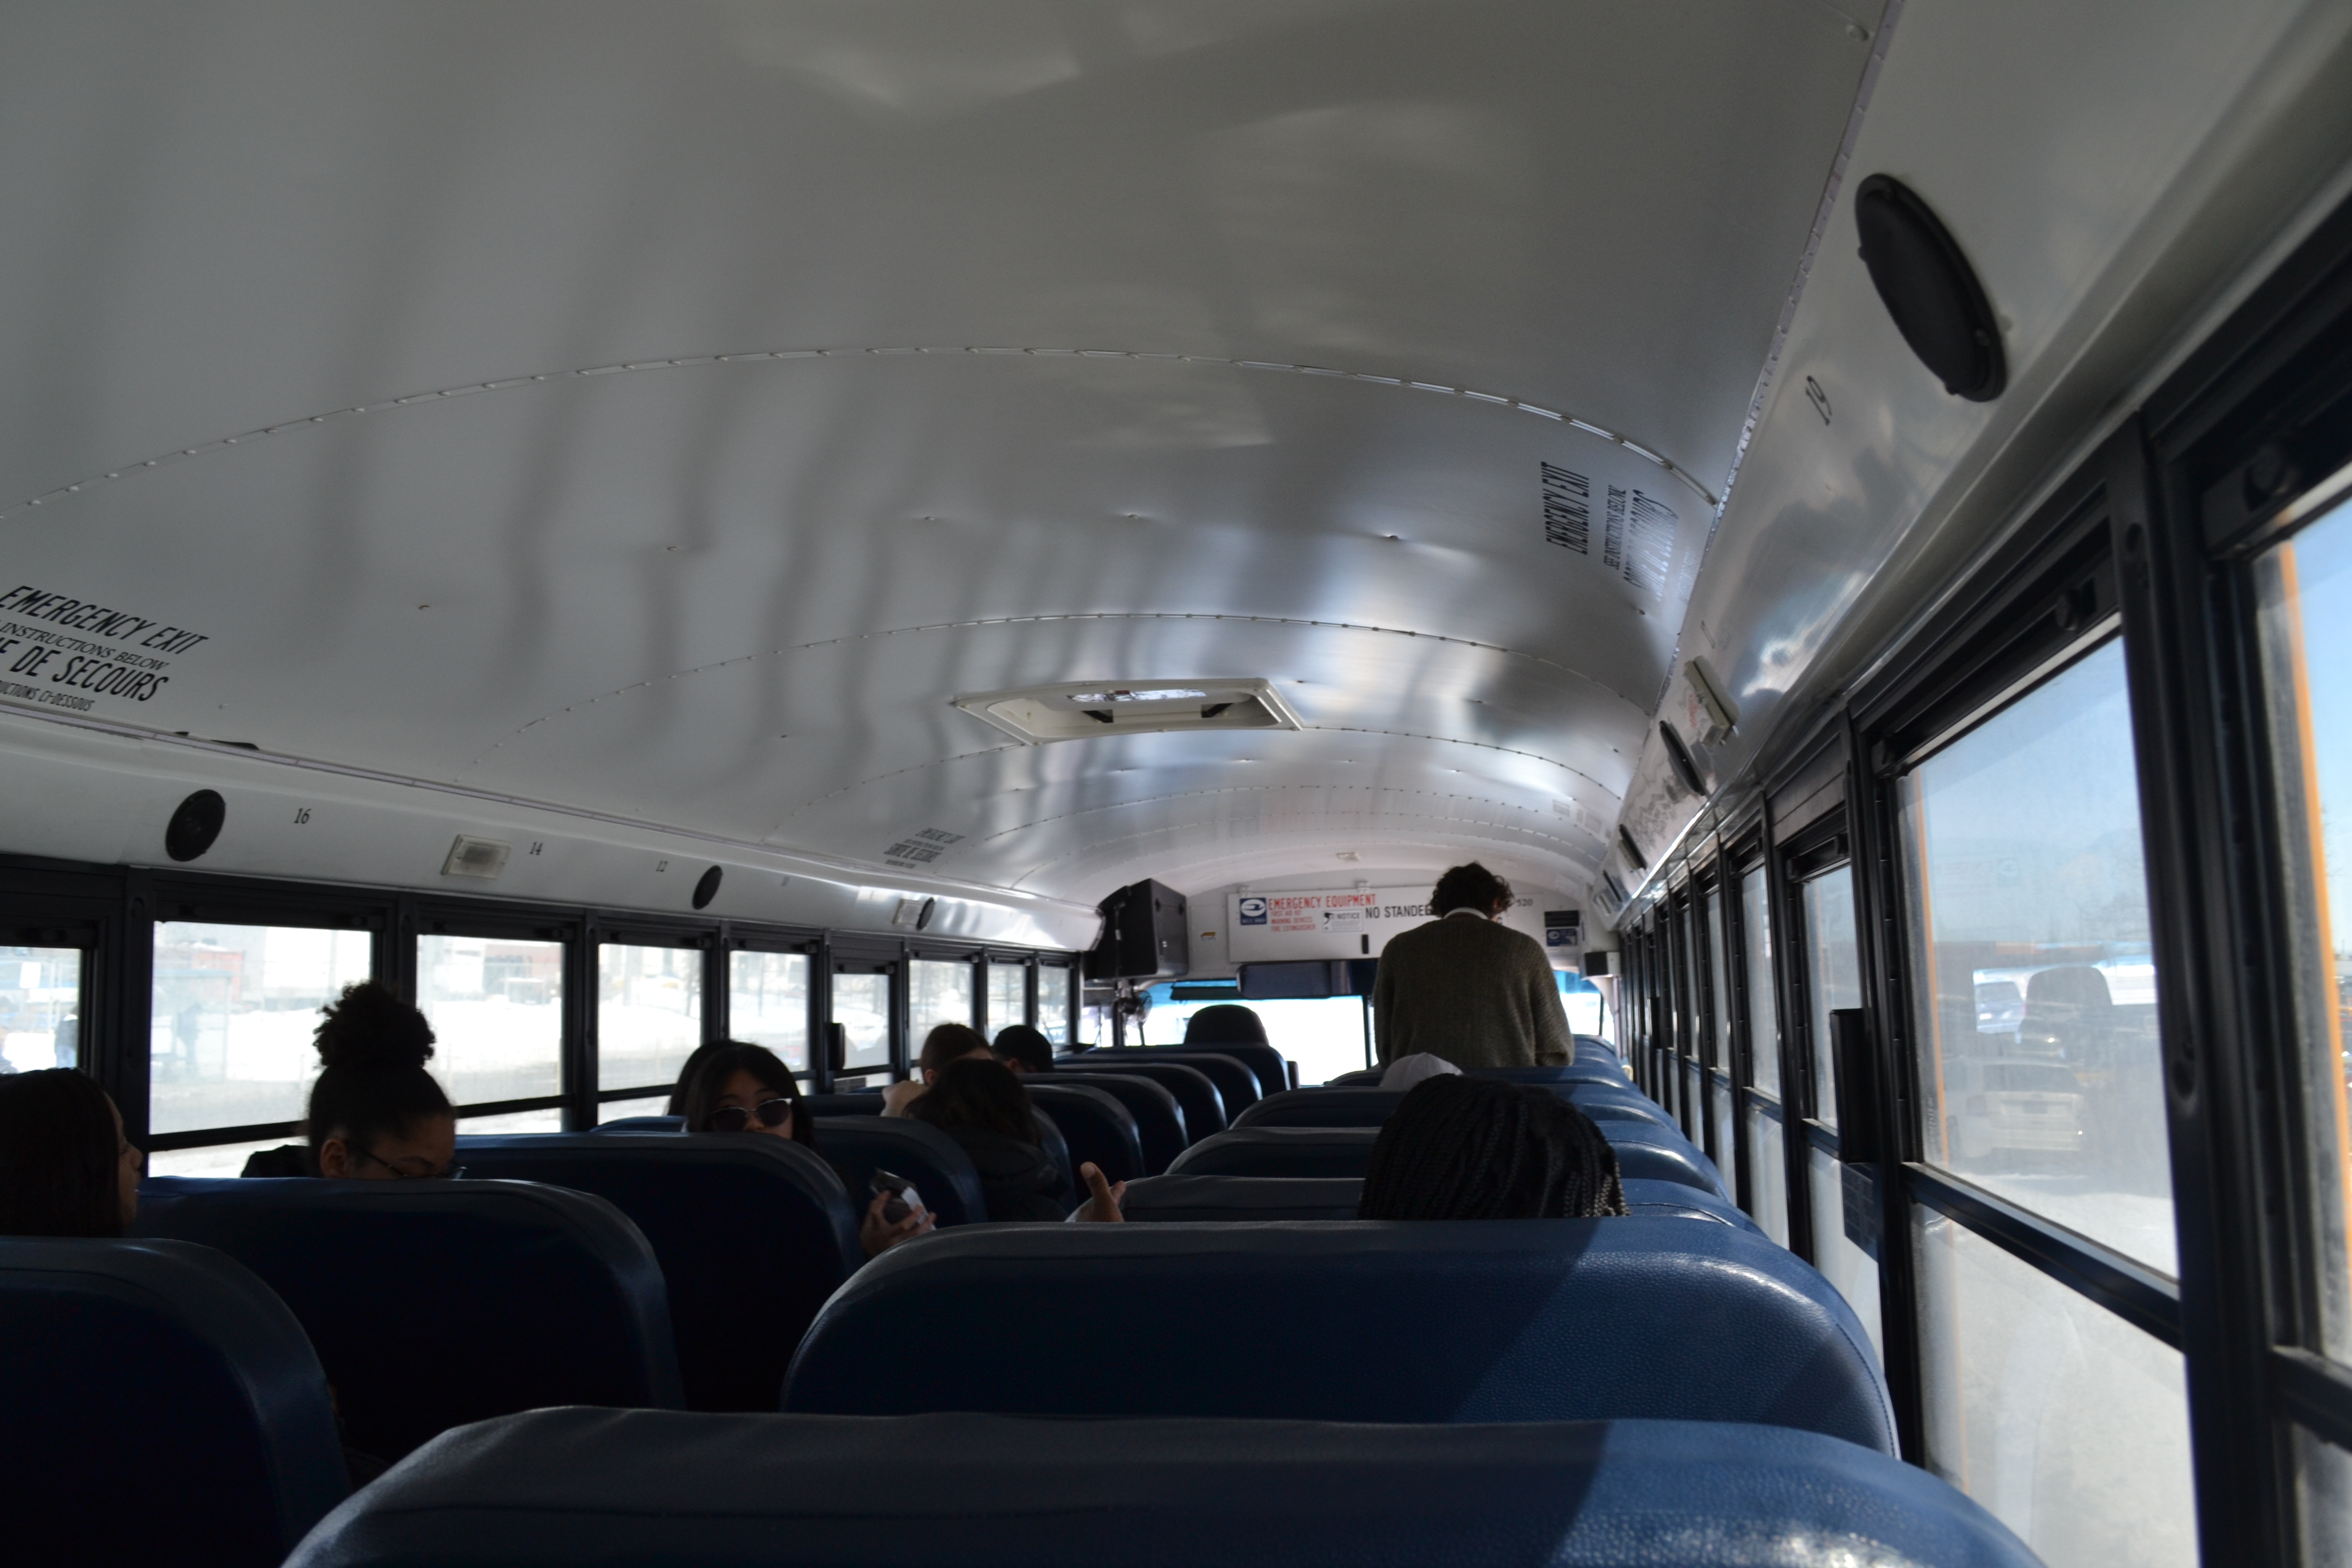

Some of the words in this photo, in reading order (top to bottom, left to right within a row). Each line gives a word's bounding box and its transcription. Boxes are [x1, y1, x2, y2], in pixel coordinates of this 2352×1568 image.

[1805, 375, 1833, 426] 19
[1540, 461, 1589, 498] EXIT
[1542, 487, 1589, 555] EMERGENCY
[0, 585, 157, 640] EMERGENCY
[140, 626, 209, 654] EXIT
[0, 622, 116, 658] INSTRUCTIONS
[114, 651, 169, 670] BELOW
[9, 646, 62, 677] DE
[52, 656, 168, 701] SECOURS
[294, 808, 311, 824] 16
[529, 842, 543, 855] 14
[1268, 896, 1321, 910] EMERGENCY
[1326, 894, 1376, 908] EQUIPMENT
[1365, 906, 1380, 919] NO
[1384, 904, 1432, 918] STANDEE
